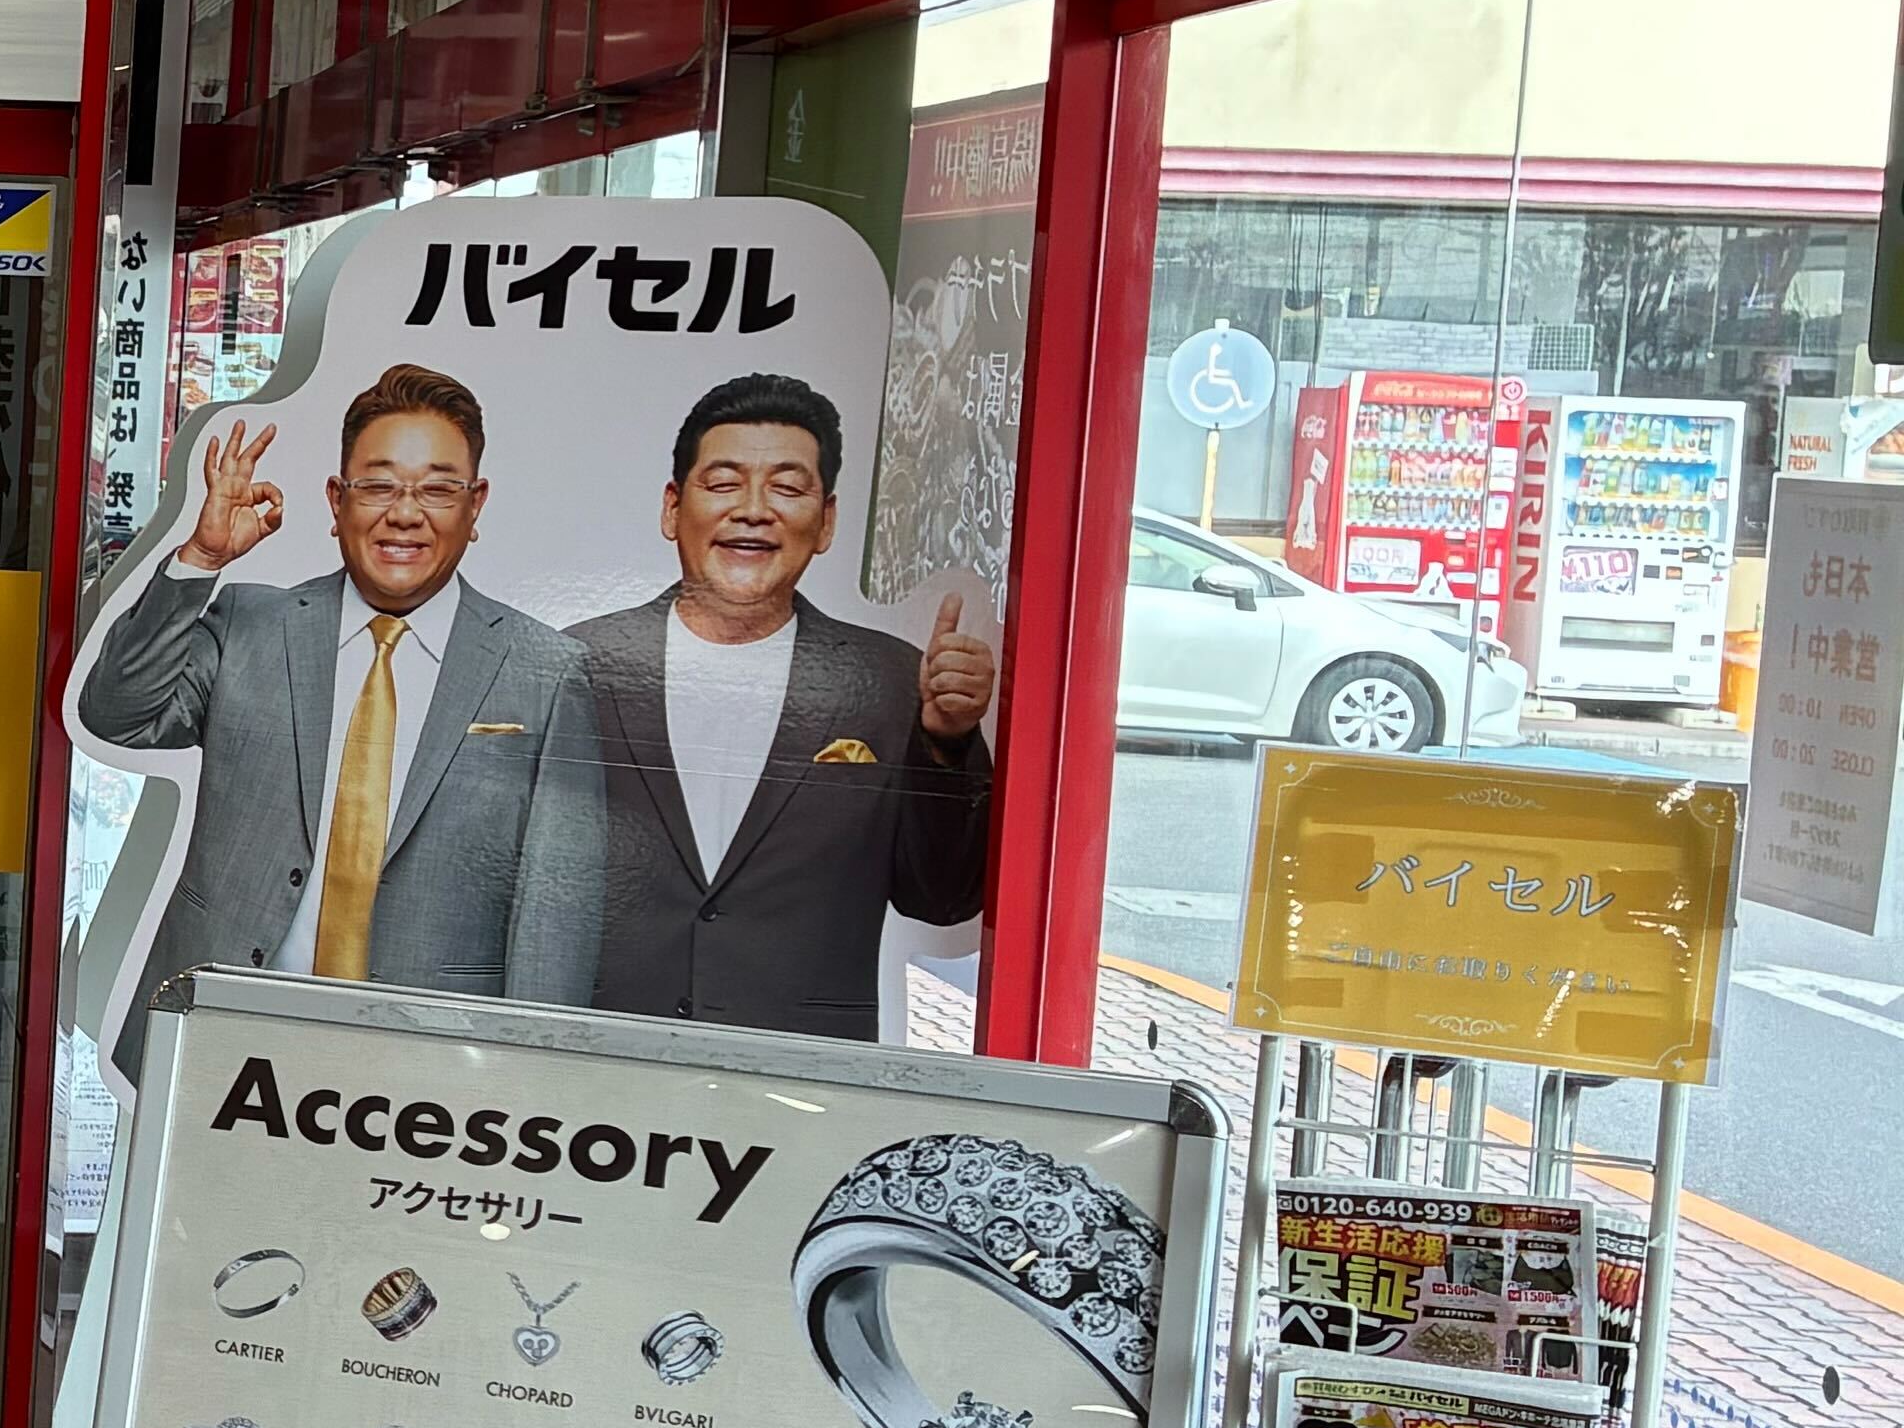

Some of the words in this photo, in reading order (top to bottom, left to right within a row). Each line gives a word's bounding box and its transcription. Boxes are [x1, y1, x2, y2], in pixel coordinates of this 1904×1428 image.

[405, 243, 795, 334] バイセル
[1789, 433, 1832, 453] NATURAL
[1788, 454, 1816, 471] FRESH
[1513, 410, 1552, 602] KIRIN
[1356, 855, 1615, 917] バイセル
[210, 1057, 775, 1223] Accessory
[368, 1177, 583, 1231] アクセサリー
[1293, 1197, 1472, 1221] 0120-640-939
[1280, 1219, 1445, 1265] 新生活応援
[214, 1339, 285, 1364] CARTIER
[341, 1357, 440, 1388] BOUCHERON
[486, 1381, 573, 1408] CHOPARD
[1410, 1389, 1463, 1407] バイセル
